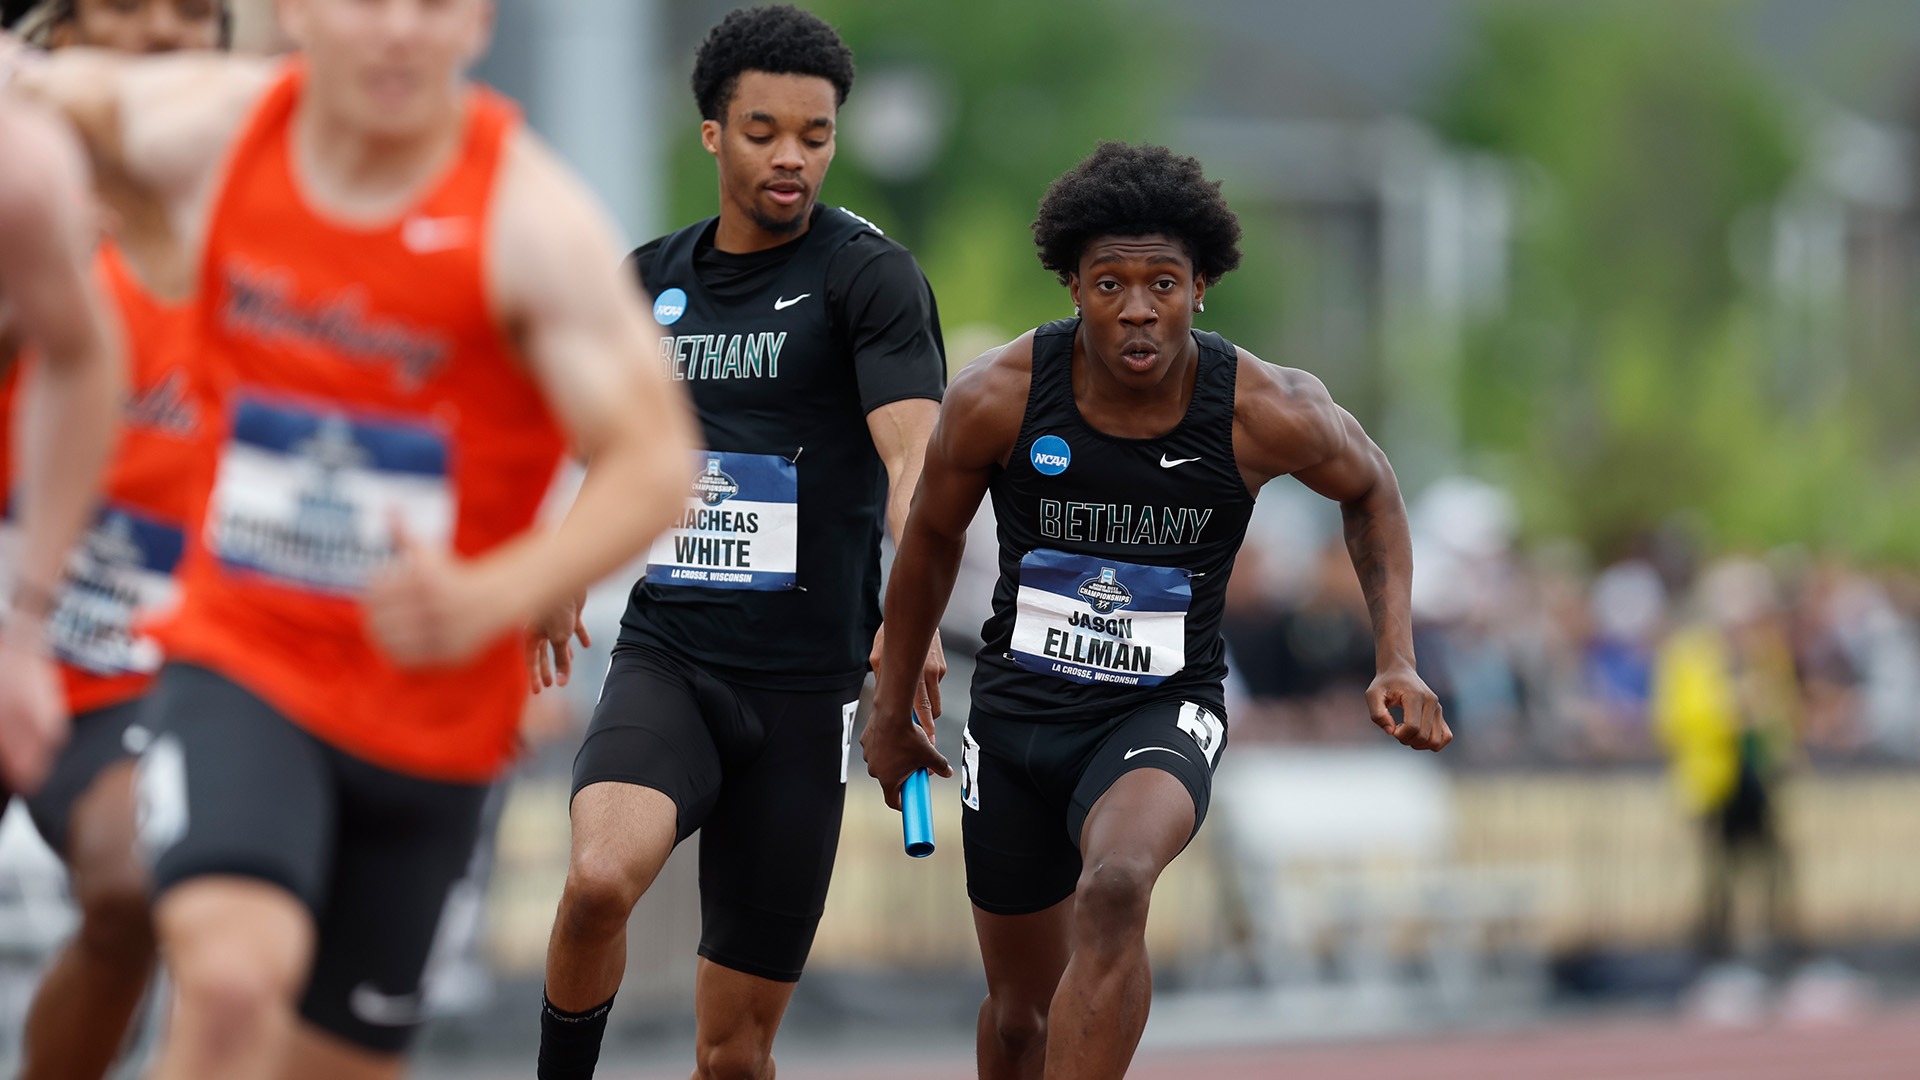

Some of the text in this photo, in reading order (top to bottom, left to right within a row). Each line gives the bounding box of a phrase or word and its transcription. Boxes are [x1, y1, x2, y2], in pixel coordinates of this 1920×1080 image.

[1034, 453, 1068, 468] NCAA
[1040, 498, 1213, 545] BETHANY
[674, 535, 751, 568] WHITE
[671, 569, 753, 583] LA CROSSE, WISCONSIN
[1079, 587, 1131, 603] CHAMPIONSHIPS
[1068, 611, 1133, 639] JASON
[1043, 627, 1151, 673] ELLMAN
[1052, 663, 1139, 685] LA CROSSE, WISCONSIN
